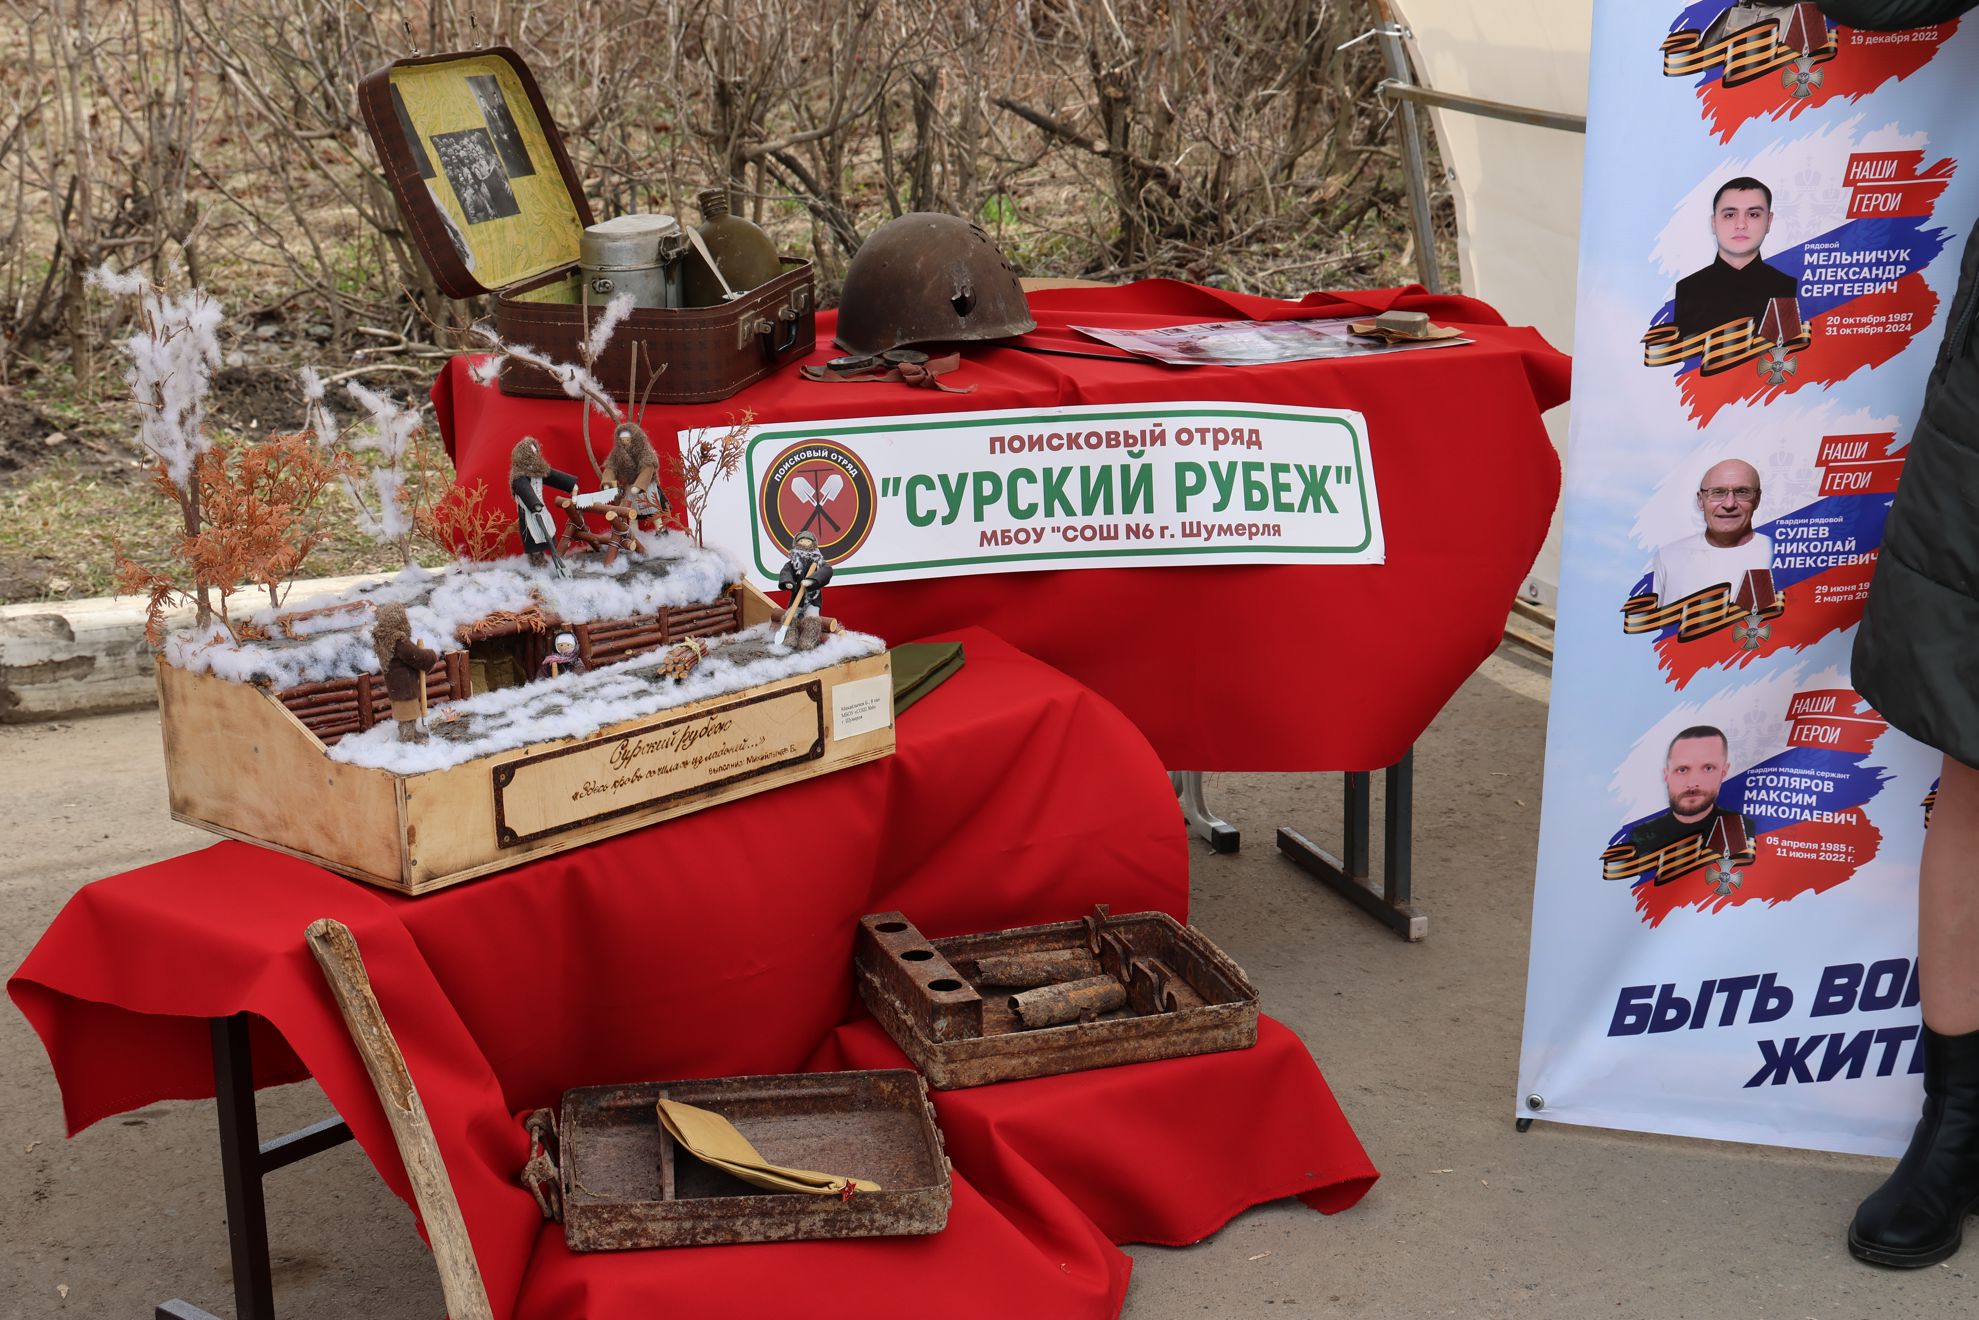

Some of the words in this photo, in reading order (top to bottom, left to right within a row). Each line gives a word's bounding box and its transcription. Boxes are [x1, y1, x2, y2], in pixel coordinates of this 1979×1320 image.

[1851, 35, 1863, 45] 19
[1865, 33, 1910, 46] декабря
[1911, 31, 1938, 42] 2022
[1850, 159, 1898, 180] НАШИ
[1853, 192, 1902, 213] ГЕРОИ
[1804, 241, 1840, 251] рядовой
[1803, 248, 1912, 266] МЕЛЬНИЧУК
[1801, 265, 1907, 282] АЛЕКСАНДР
[1800, 281, 1898, 298] СЕРГЕЕВИЧ
[1826, 316, 1840, 326] 20
[1842, 314, 1886, 325] октября
[1888, 312, 1914, 323] 1987
[1825, 327, 1838, 336] 31
[1840, 325, 1883, 336] октября
[1885, 323, 1912, 333] 2024
[989, 422, 1167, 455] поисковый
[1174, 427, 1263, 451] отряд
[1822, 441, 1869, 461] НАШИ
[773, 448, 829, 483] ПОИСКОВЫЙ
[830, 453, 859, 478] ОТРЯД
[881, 449, 1155, 528] "СУРСКИЙ
[1174, 460, 1352, 514] РУБЕЖ"
[1825, 471, 1873, 491] ГЕРОИ
[1776, 518, 1809, 527] гвардии
[1809, 516, 1844, 526] рядовой
[979, 526, 1046, 548] МБОУ
[1051, 523, 1119, 543] "СОШ
[1159, 525, 1175, 539] г.
[1181, 520, 1282, 542] Шумерля
[1775, 526, 1830, 540] СУЛЕВ
[1774, 536, 1857, 555] НИКОЛАЙ
[1815, 585, 1829, 594] 29
[1830, 584, 1857, 593] июня
[1858, 582, 1870, 590] 19
[1815, 595, 1822, 604] 2
[1823, 594, 1854, 604] марта
[1855, 591, 1869, 600] 20
[1791, 696, 1837, 715] НАШИ
[1793, 725, 1841, 744] ГЕРОИ
[1746, 767, 1778, 775] гвардии
[1778, 767, 1815, 776] младший
[1816, 770, 1850, 780] сержант
[1745, 775, 1834, 793] СТОЛЯРОВ
[1744, 789, 1817, 807] МАКСИМ
[1742, 803, 1857, 826] НИКОЛАЕВИЧ
[1766, 836, 1779, 845] 05
[1780, 839, 1819, 850] апреля
[1820, 842, 1847, 852] 1985
[1848, 845, 1856, 853] г.
[1776, 848, 1787, 857] 11
[1789, 850, 1817, 860] июня
[1819, 852, 1846, 862] 2022
[1607, 972, 1794, 1037] БЫТЬ
